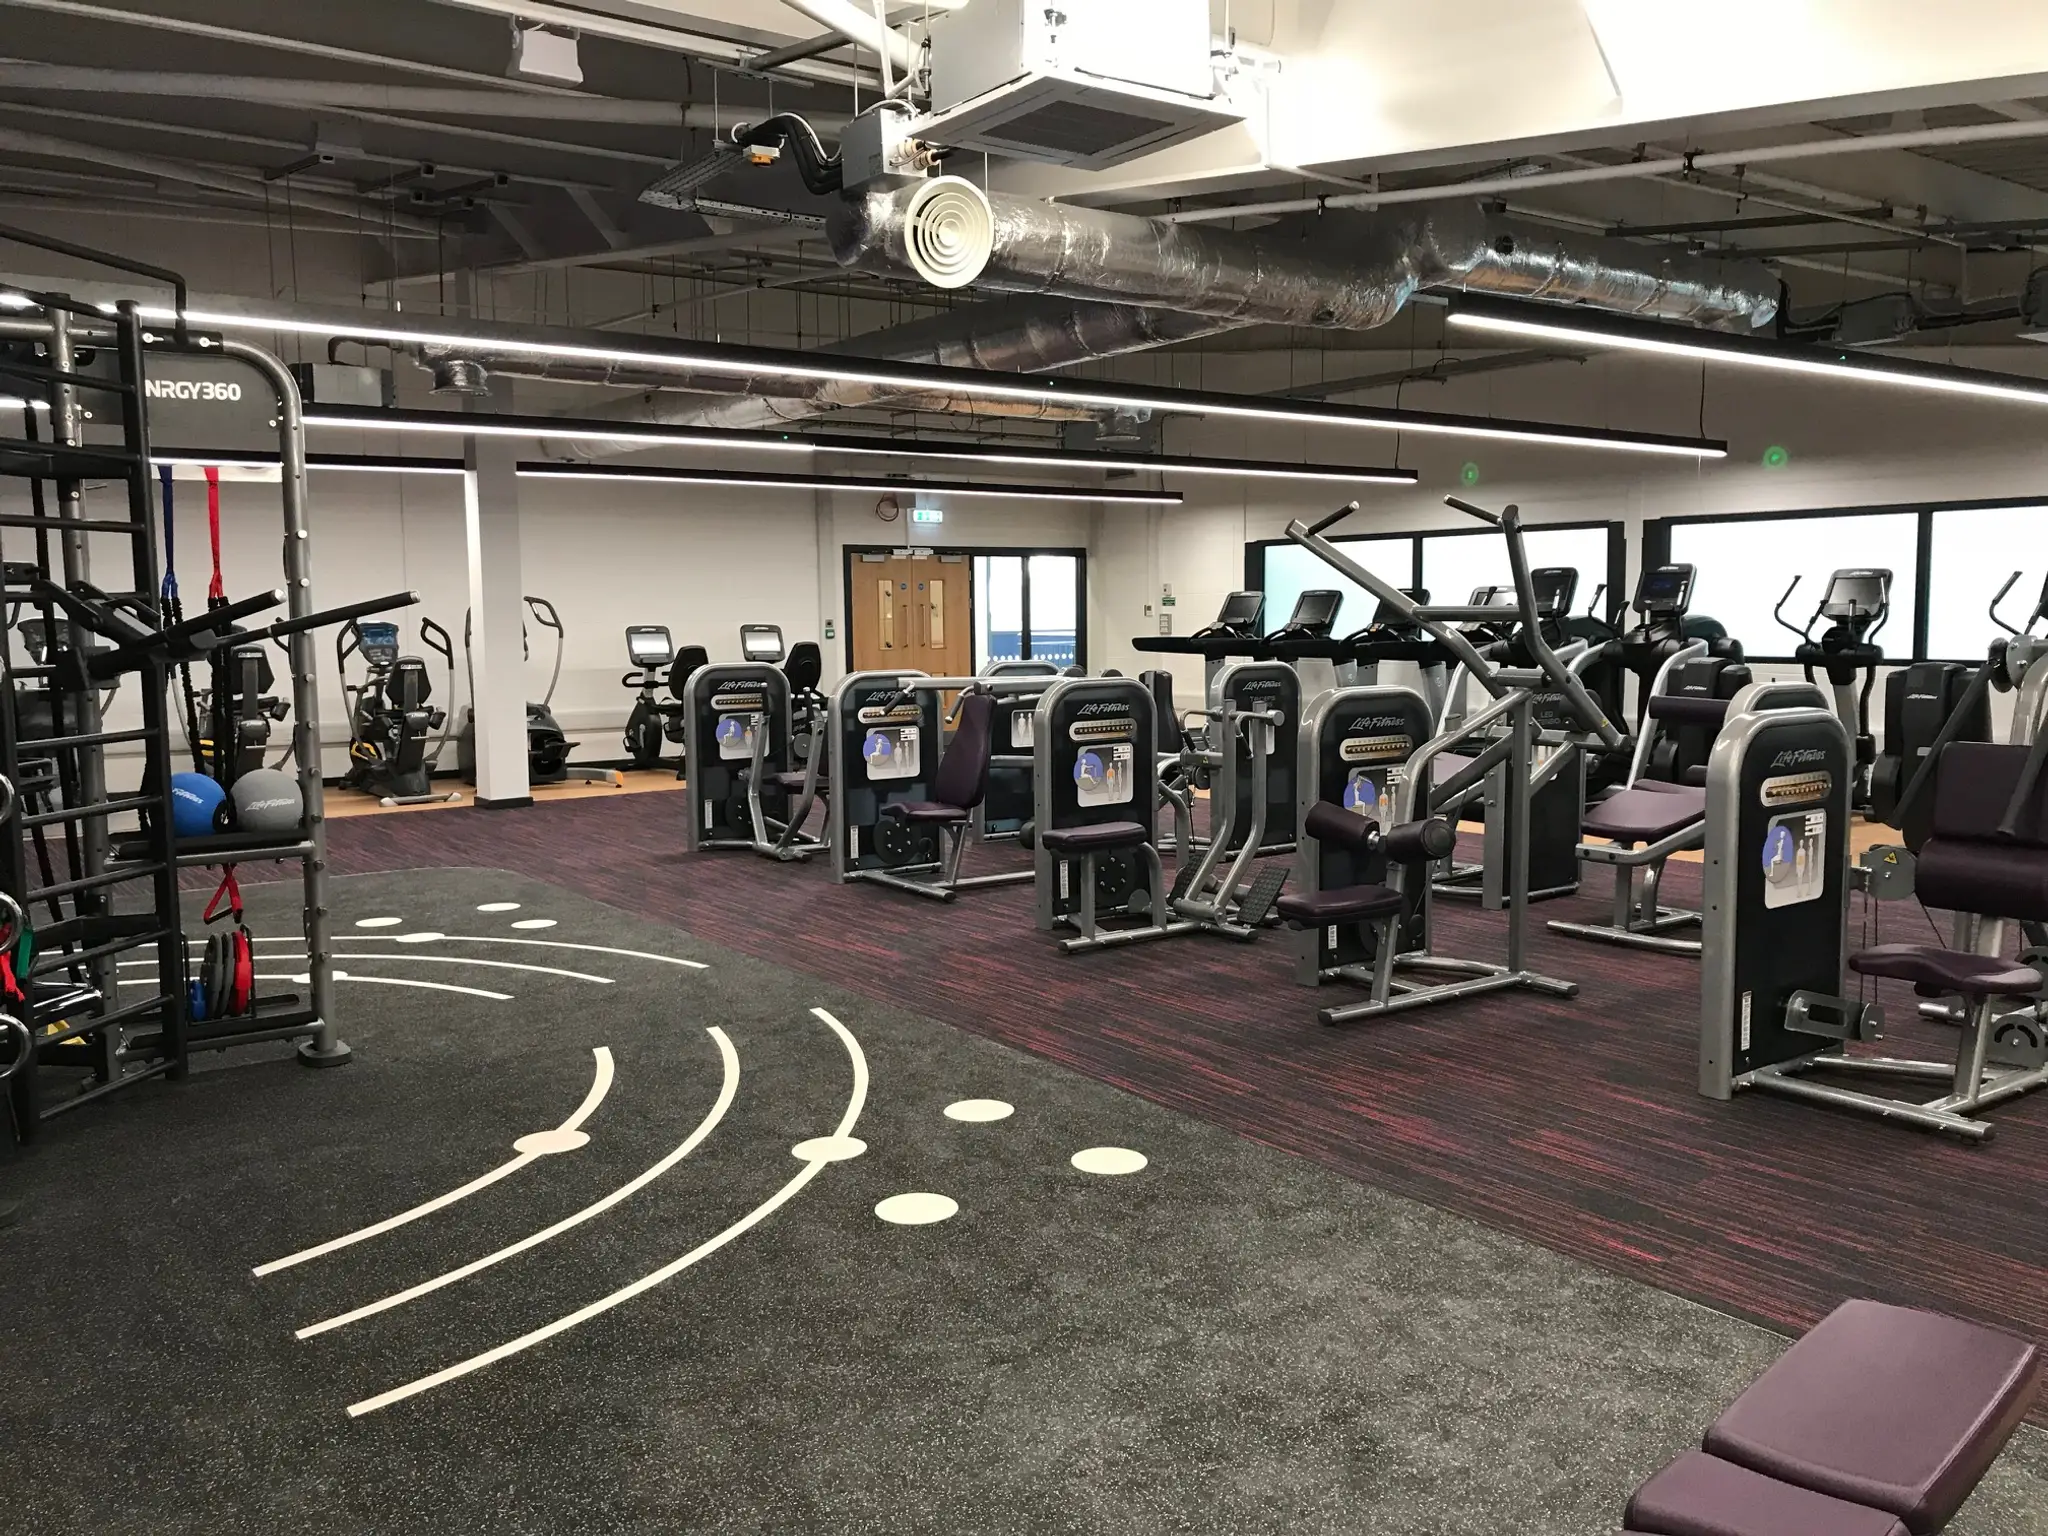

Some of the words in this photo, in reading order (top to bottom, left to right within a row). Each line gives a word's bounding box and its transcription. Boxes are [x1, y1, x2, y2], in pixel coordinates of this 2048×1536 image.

[145, 379, 241, 401] NRGY360
[1348, 717, 1370, 730] Life
[1369, 717, 1405, 729] Fitness
[1770, 750, 1792, 768] Life
[1791, 749, 1826, 766] Fitness
